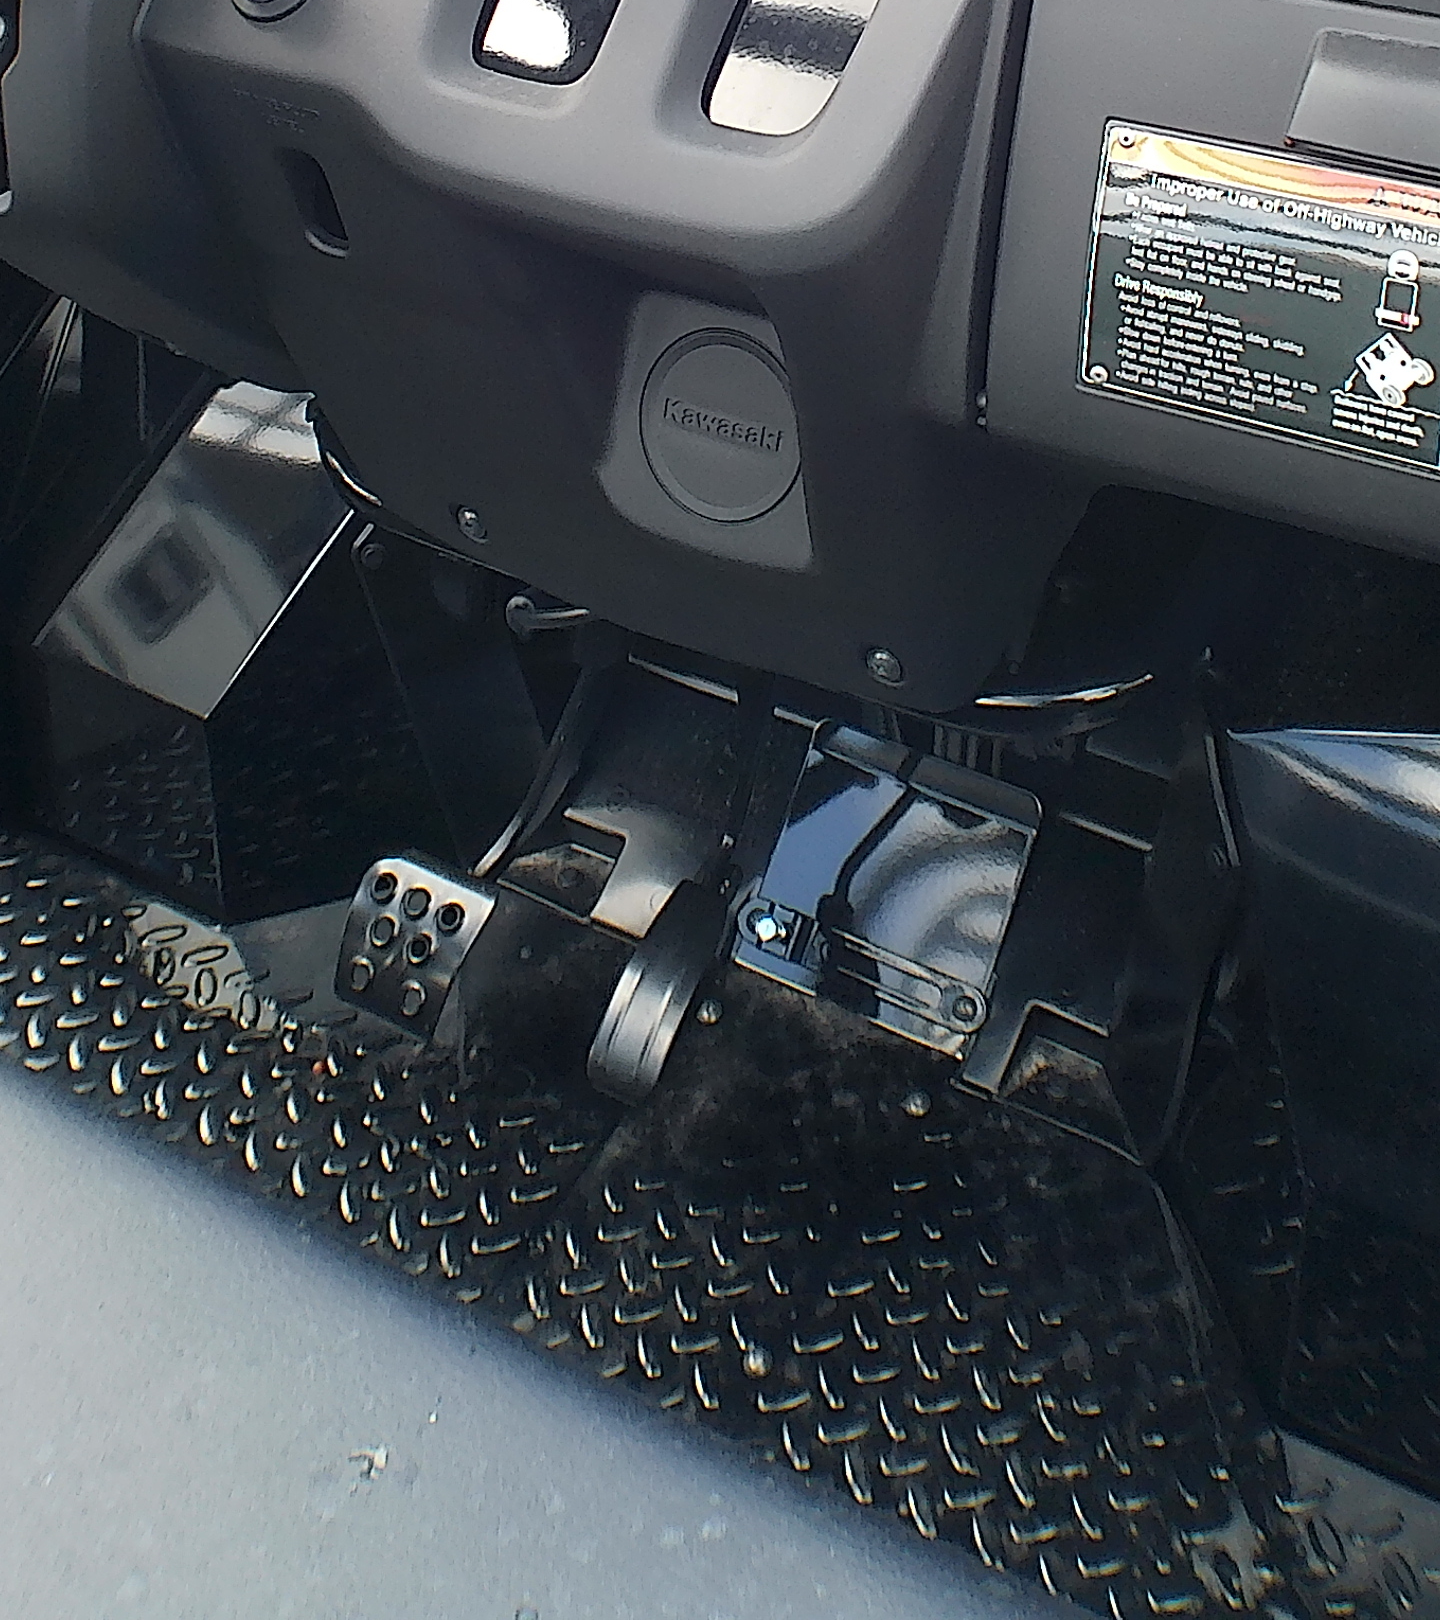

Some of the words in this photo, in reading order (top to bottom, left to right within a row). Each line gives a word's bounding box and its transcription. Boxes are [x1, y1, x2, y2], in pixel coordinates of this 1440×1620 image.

[1125, 191, 1140, 206] Be
[1140, 194, 1187, 219] Prepared
[1150, 173, 1223, 205] Improper
[1227, 188, 1258, 209] Use
[1262, 195, 1280, 213] of
[1283, 199, 1386, 238] Off-Highway
[1114, 273, 1141, 291] Drive
[1141, 279, 1204, 309] Responsibly
[663, 397, 784, 452] Kawasaki
